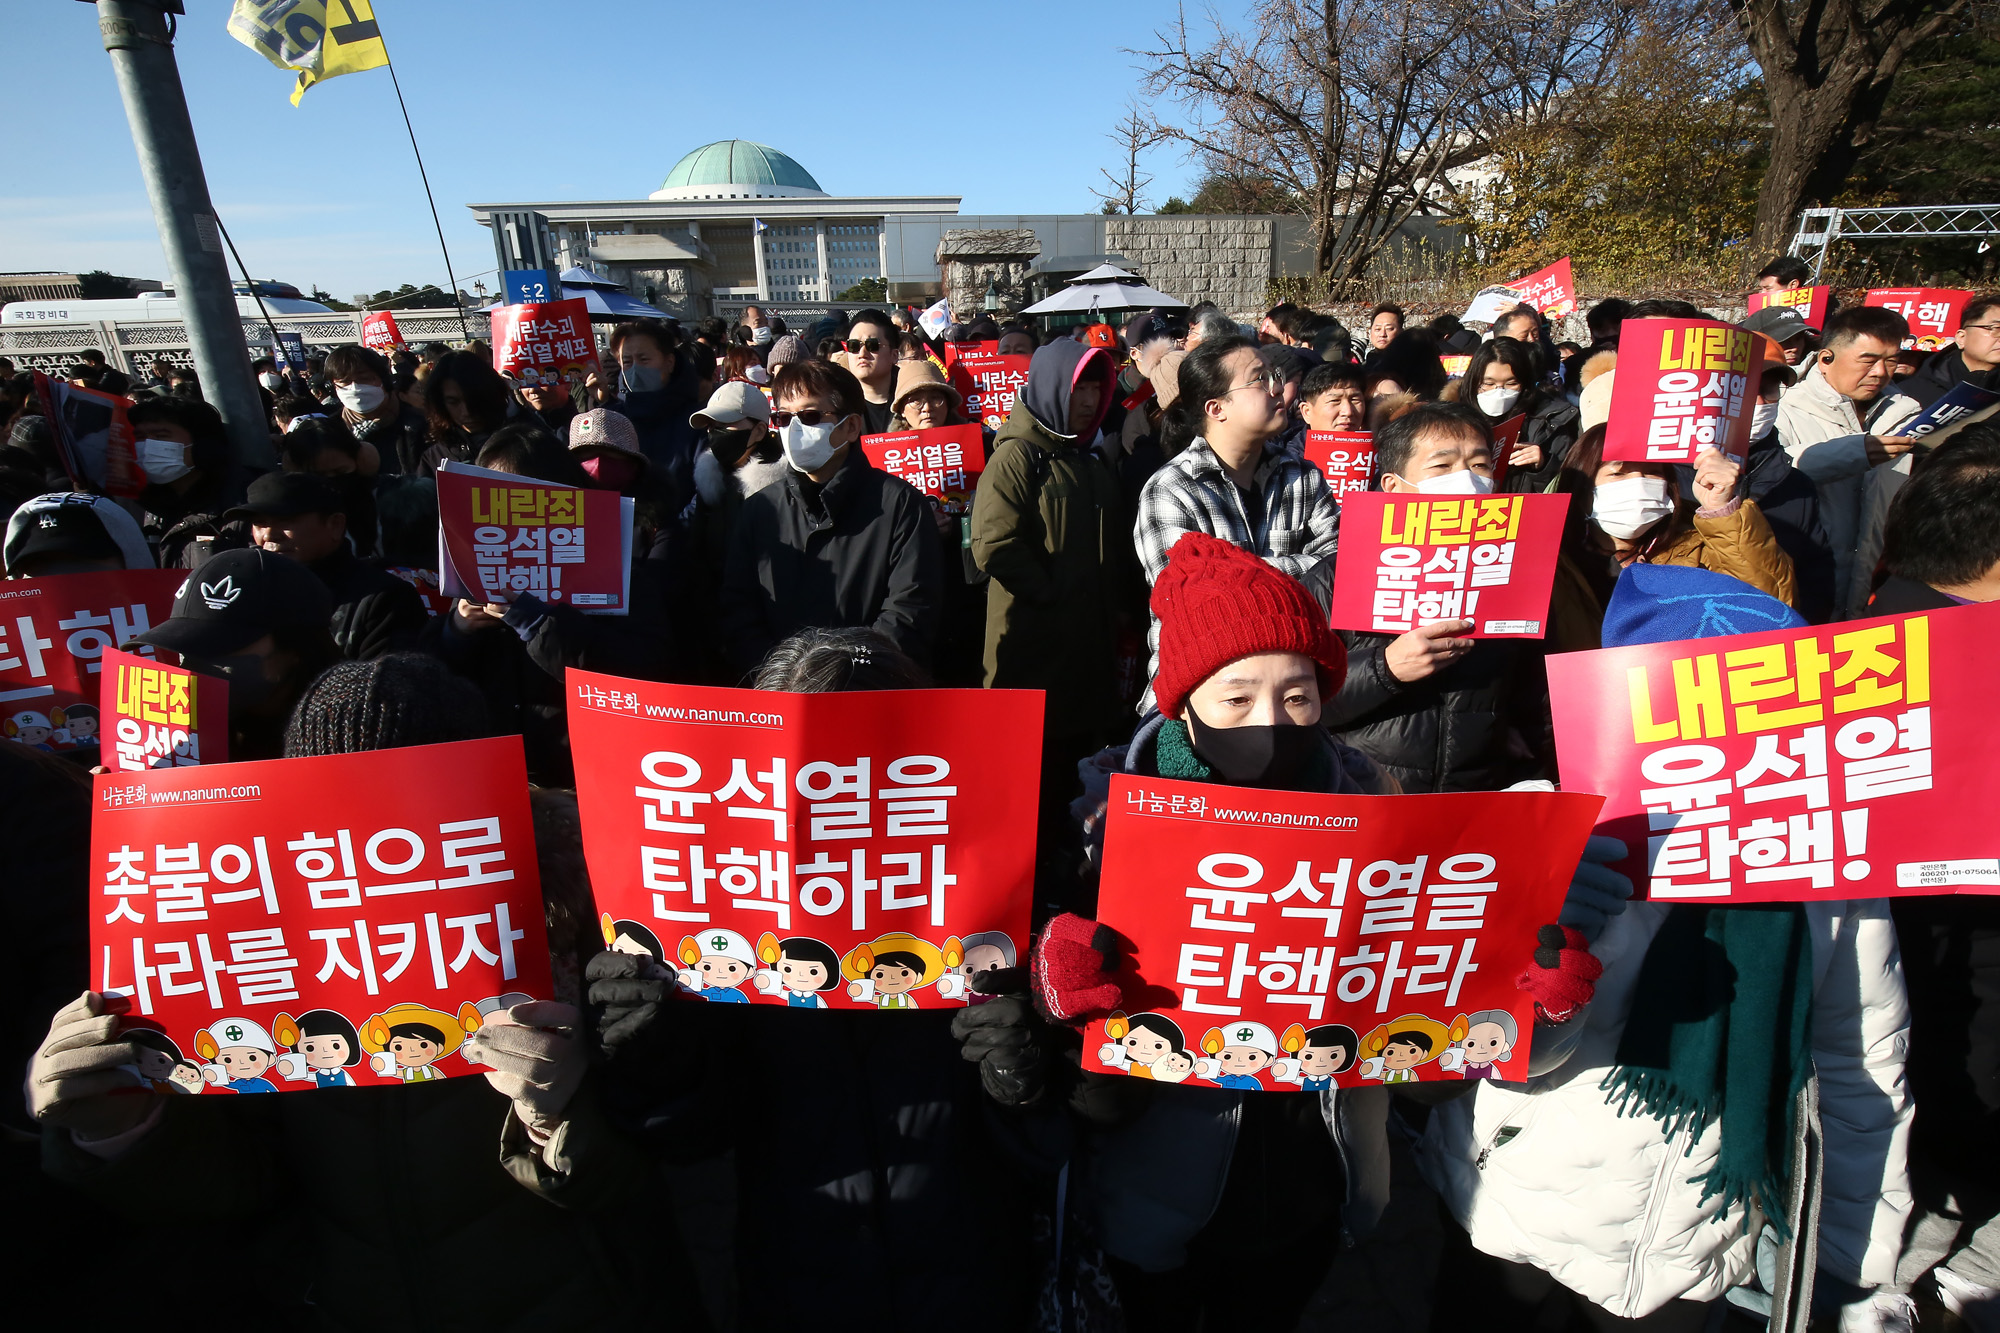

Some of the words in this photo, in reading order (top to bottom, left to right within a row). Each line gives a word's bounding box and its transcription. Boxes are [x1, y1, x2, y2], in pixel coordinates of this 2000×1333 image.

[505, 223, 521, 259] 1
[533, 283, 545, 298] 2
[15, 311, 69, 320] 국회경비대
[505, 316, 576, 343] 내란수괴
[500, 342, 554, 366] 윤석열
[555, 338, 590, 360] 체포
[1658, 327, 1754, 375] 내란죄
[966, 391, 1015, 414] 윤석열
[1653, 372, 1747, 417] 윤석열
[883, 442, 964, 473] 윤석열을
[1645, 415, 1730, 460] 탄핵!
[898, 466, 967, 495] 핵하라
[472, 487, 585, 526] 내란죄
[1380, 496, 1524, 546] 내란죄
[473, 526, 585, 565] 윤석열
[1376, 542, 1516, 590] 윤석열
[477, 565, 563, 603] 탄핵!
[1372, 589, 1480, 631] 탄핵!
[116, 664, 198, 730] 내란죄
[1627, 615, 1930, 744] 내란죄
[579, 684, 640, 715] 나눔문화
[644, 702, 783, 727] www.nanum.com
[1640, 706, 1933, 832] 윤석열
[103, 783, 148, 807] 나눔문화
[151, 783, 261, 804] www.nanum.com
[635, 751, 958, 842] 윤석열을
[1126, 789, 1209, 819] 나눔문화
[1214, 805, 1359, 828] www.nanum.com
[103, 835, 280, 924] 촛불의
[286, 817, 515, 910] 힘으로
[1648, 807, 1871, 899] 탄핵!
[640, 844, 957, 930] 탄핵하라
[1185, 852, 1499, 938] 윤석열을
[103, 927, 299, 1015] 나라를
[308, 903, 525, 996] 지키자
[1176, 938, 1480, 1020] 탄핵하라
